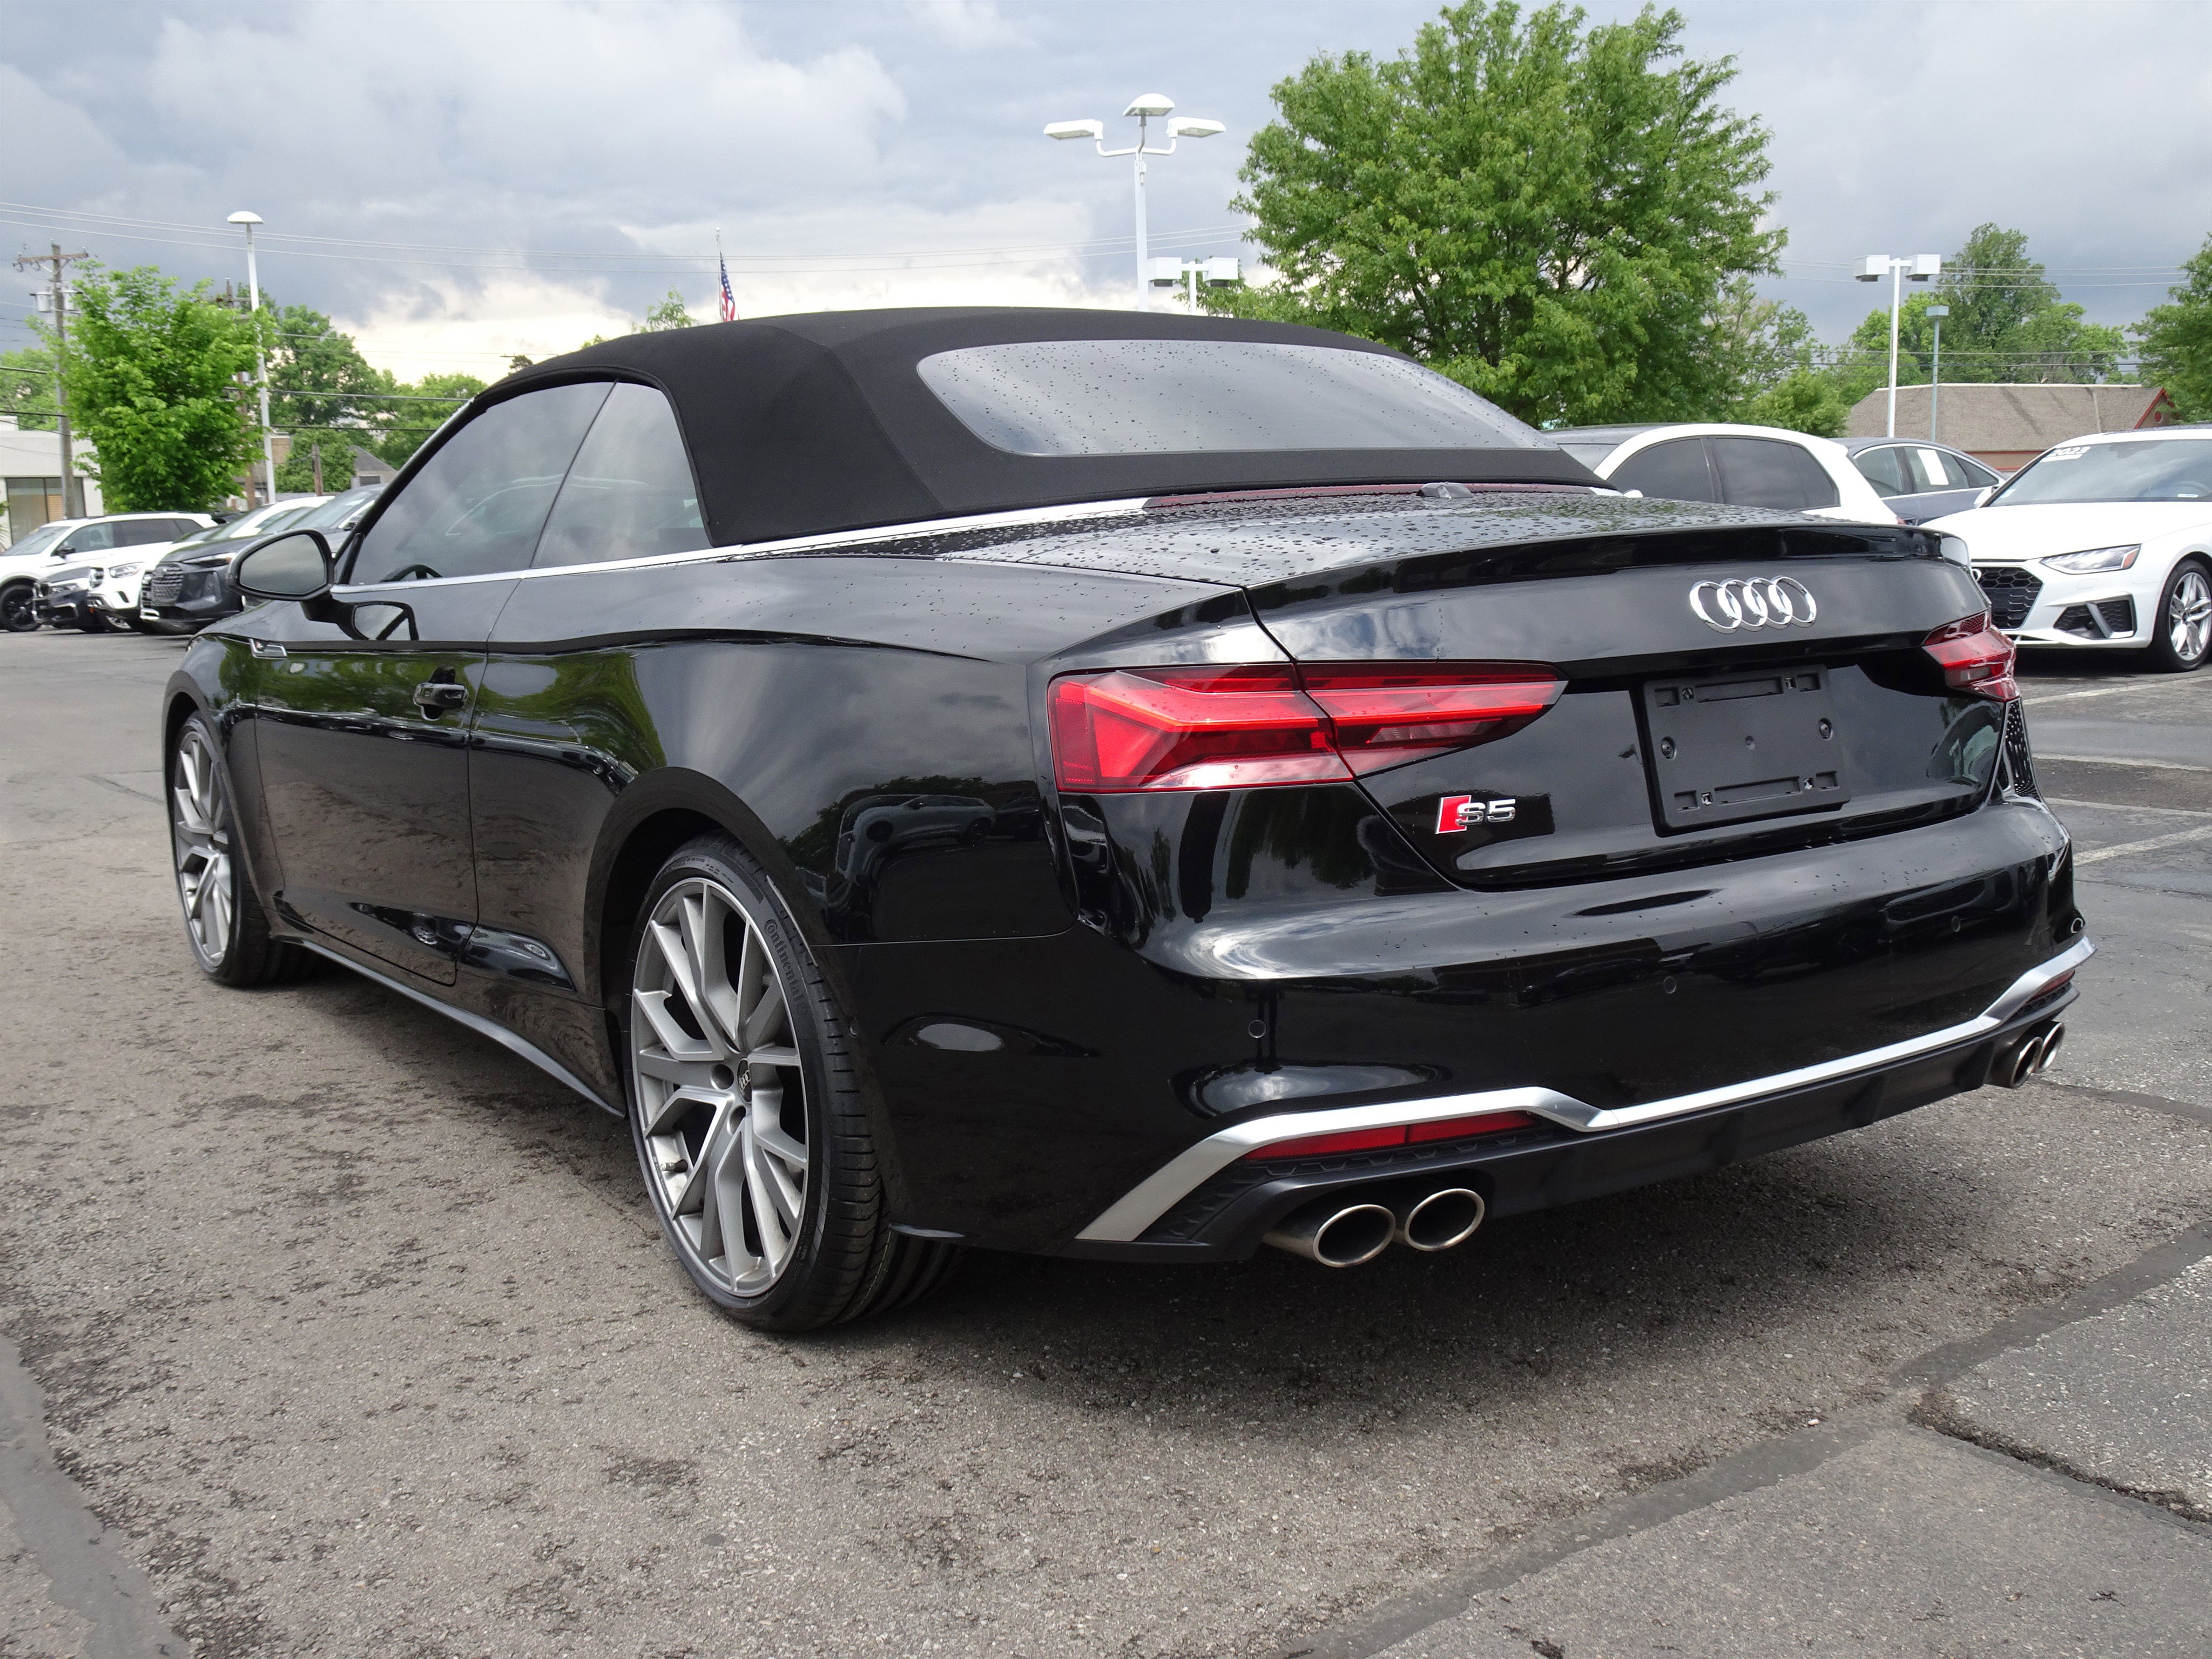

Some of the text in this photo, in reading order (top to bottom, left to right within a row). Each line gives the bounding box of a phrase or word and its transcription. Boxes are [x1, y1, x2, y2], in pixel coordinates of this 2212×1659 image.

[2047, 447, 2091, 457] 2023
[1455, 799, 1516, 826] S5
[764, 919, 804, 1002] Continental
